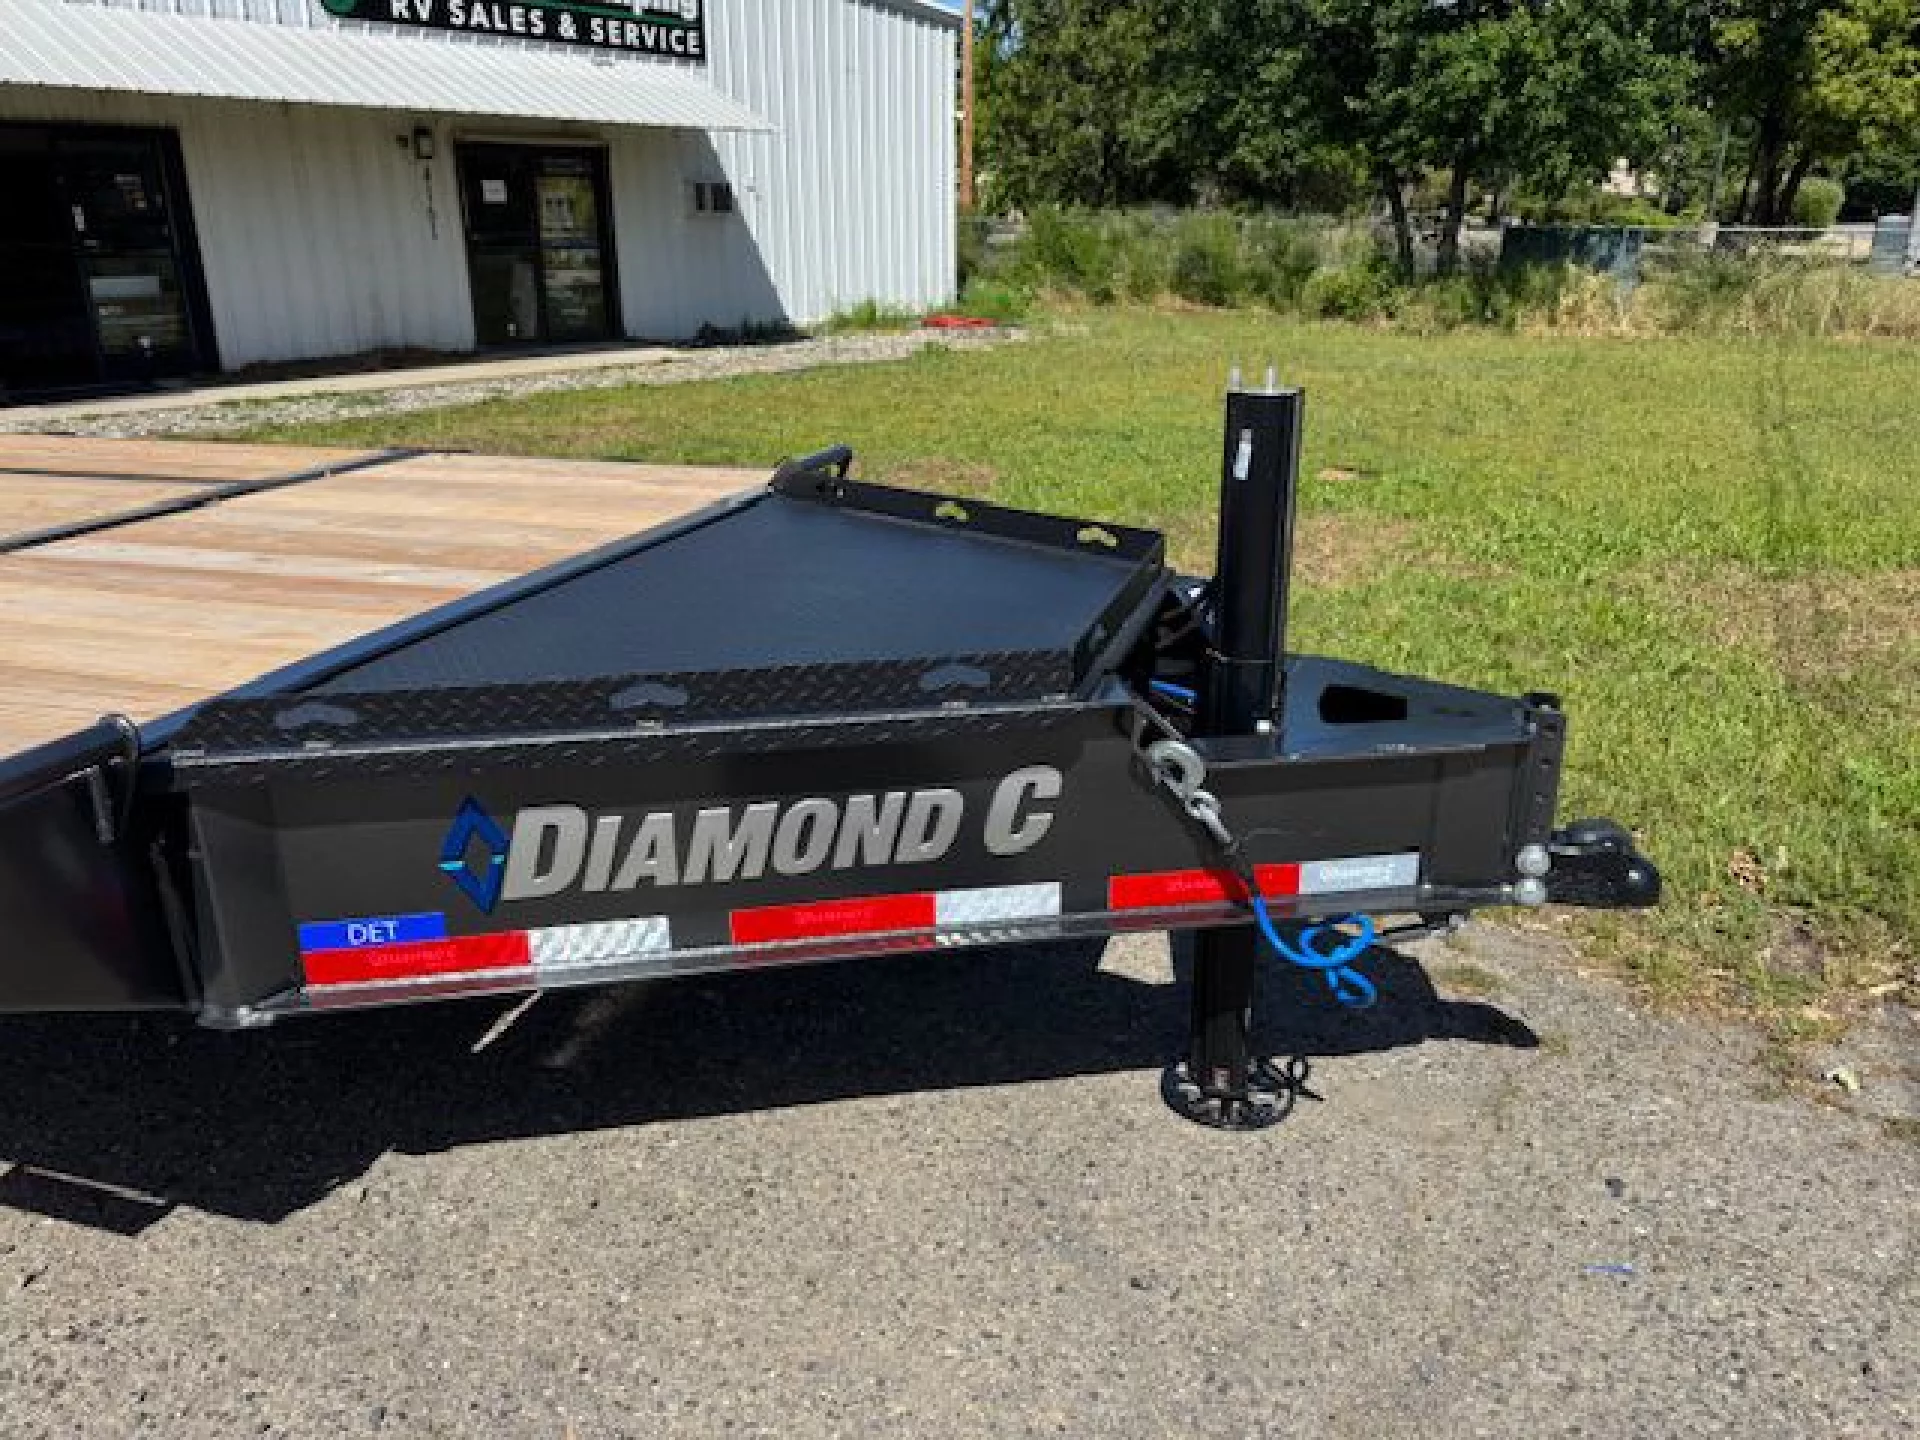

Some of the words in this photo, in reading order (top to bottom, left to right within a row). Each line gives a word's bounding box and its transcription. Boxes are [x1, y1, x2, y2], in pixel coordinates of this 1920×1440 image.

[390, 0, 430, 21] RV
[449, 0, 546, 36] SALES
[558, 12, 579, 39] &
[590, 17, 700, 54] SERVICE
[983, 764, 1064, 856] C
[347, 919, 399, 946] DET
